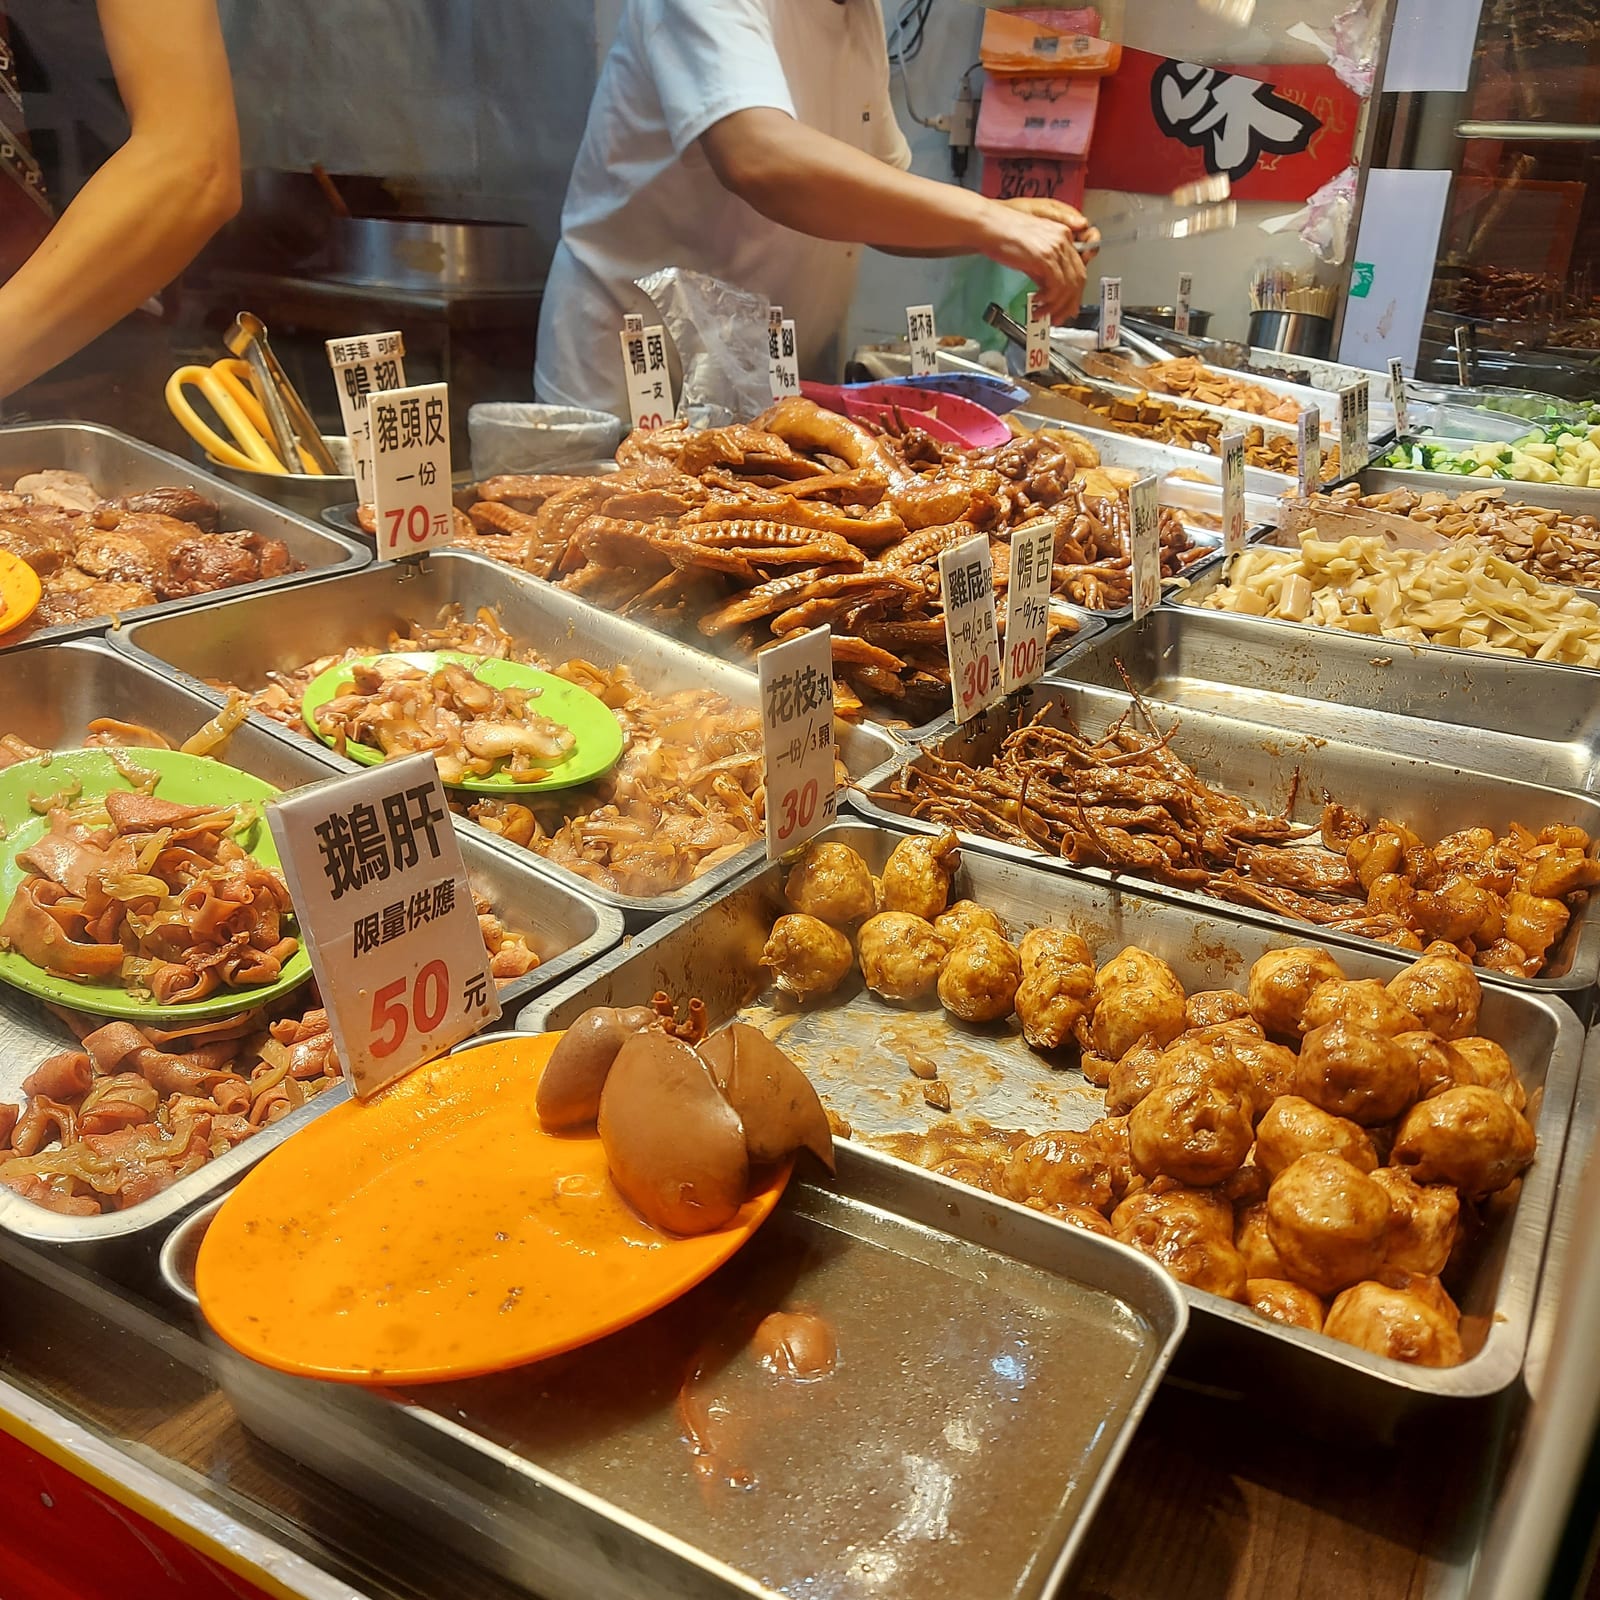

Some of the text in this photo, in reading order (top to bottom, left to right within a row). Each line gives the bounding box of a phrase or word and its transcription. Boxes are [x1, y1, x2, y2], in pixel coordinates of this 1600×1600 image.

[333, 342, 370, 362] 附手套
[628, 335, 665, 376] 鴨頭
[641, 382, 664, 399] 一支
[377, 396, 445, 453] 豬頭皮
[396, 462, 436, 486] 一份
[948, 560, 992, 611] 雞屁股
[1017, 533, 1051, 592] 鴨舌
[1015, 597, 1045, 629] 一份/7支
[767, 665, 832, 728] 花枝丸
[314, 781, 444, 900] 鵝肝
[353, 879, 456, 959] 限量供應
